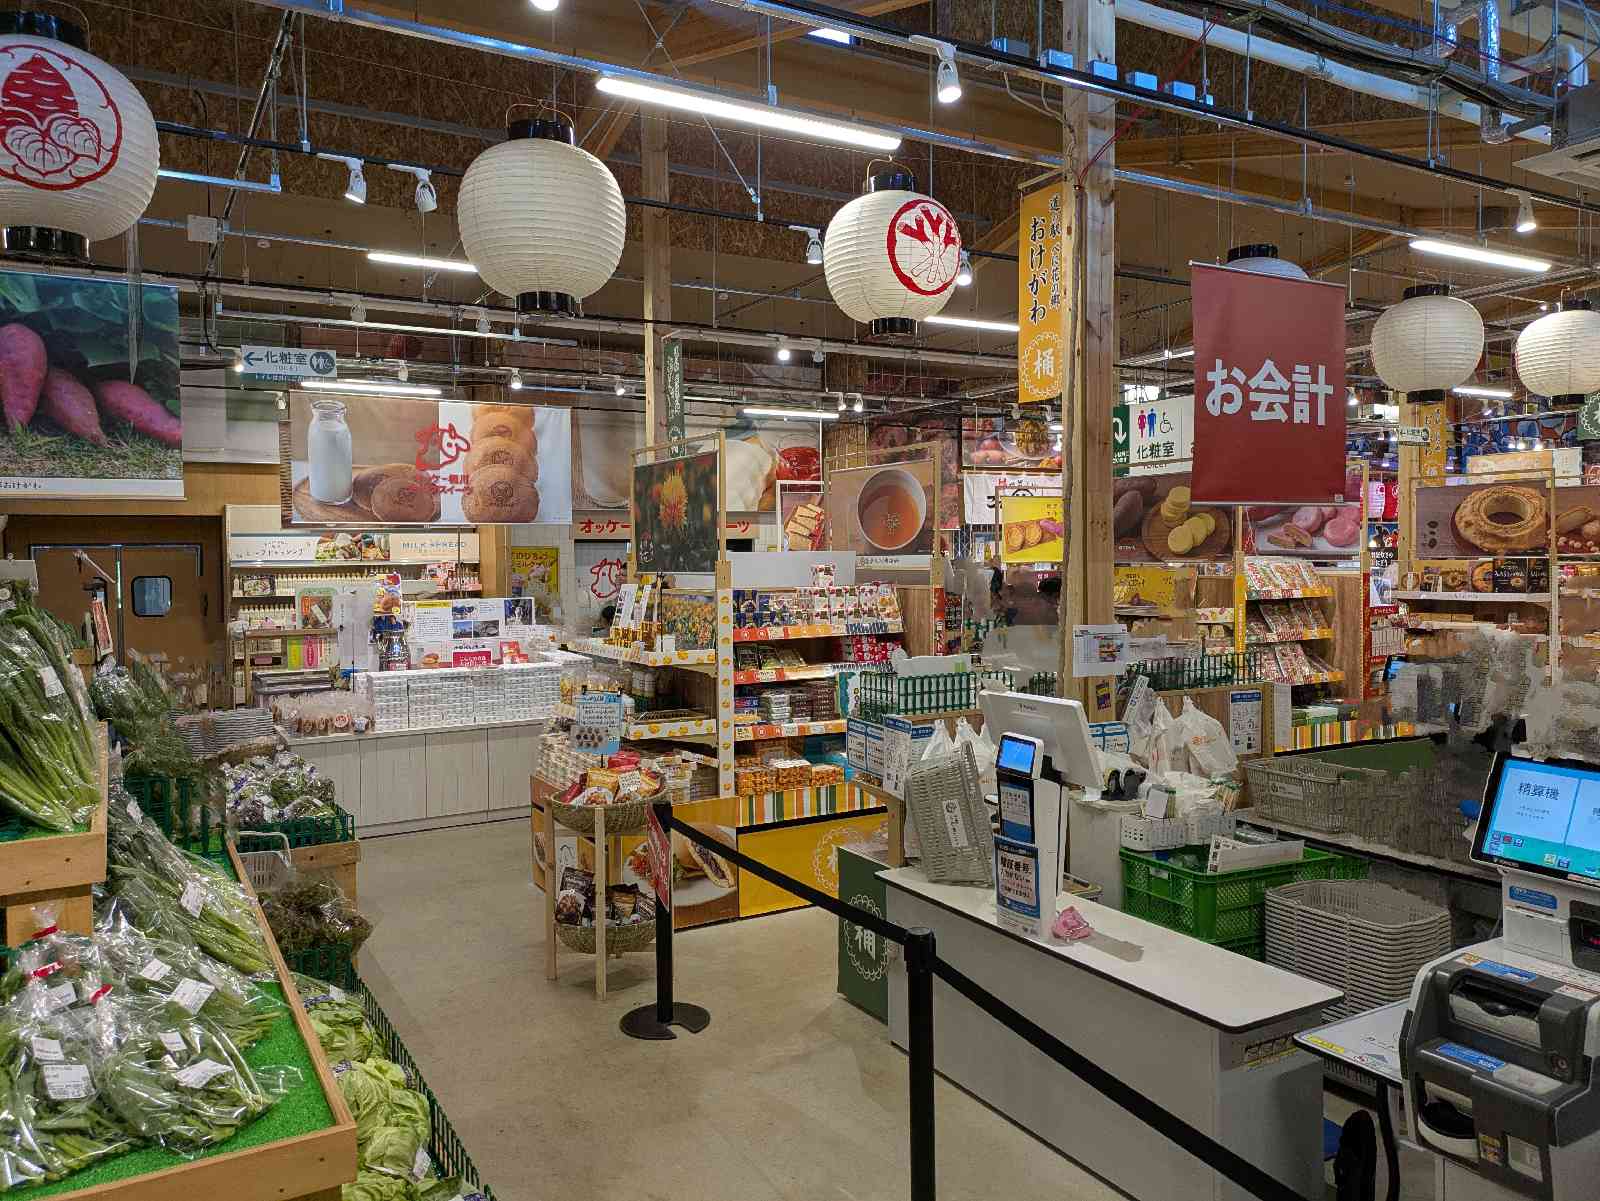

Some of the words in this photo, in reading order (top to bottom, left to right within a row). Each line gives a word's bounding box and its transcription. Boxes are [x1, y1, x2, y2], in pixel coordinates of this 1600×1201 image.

[1049, 195, 1062, 238] 道の駅
[1029, 216, 1048, 325] おけがわ
[264, 350, 308, 365] 化粧室
[1033, 348, 1055, 379] 桶
[1205, 358, 1334, 426] お会計
[1136, 440, 1175, 460] 化粧室
[579, 519, 633, 534] オッケー
[1519, 782, 1560, 801] 精算機
